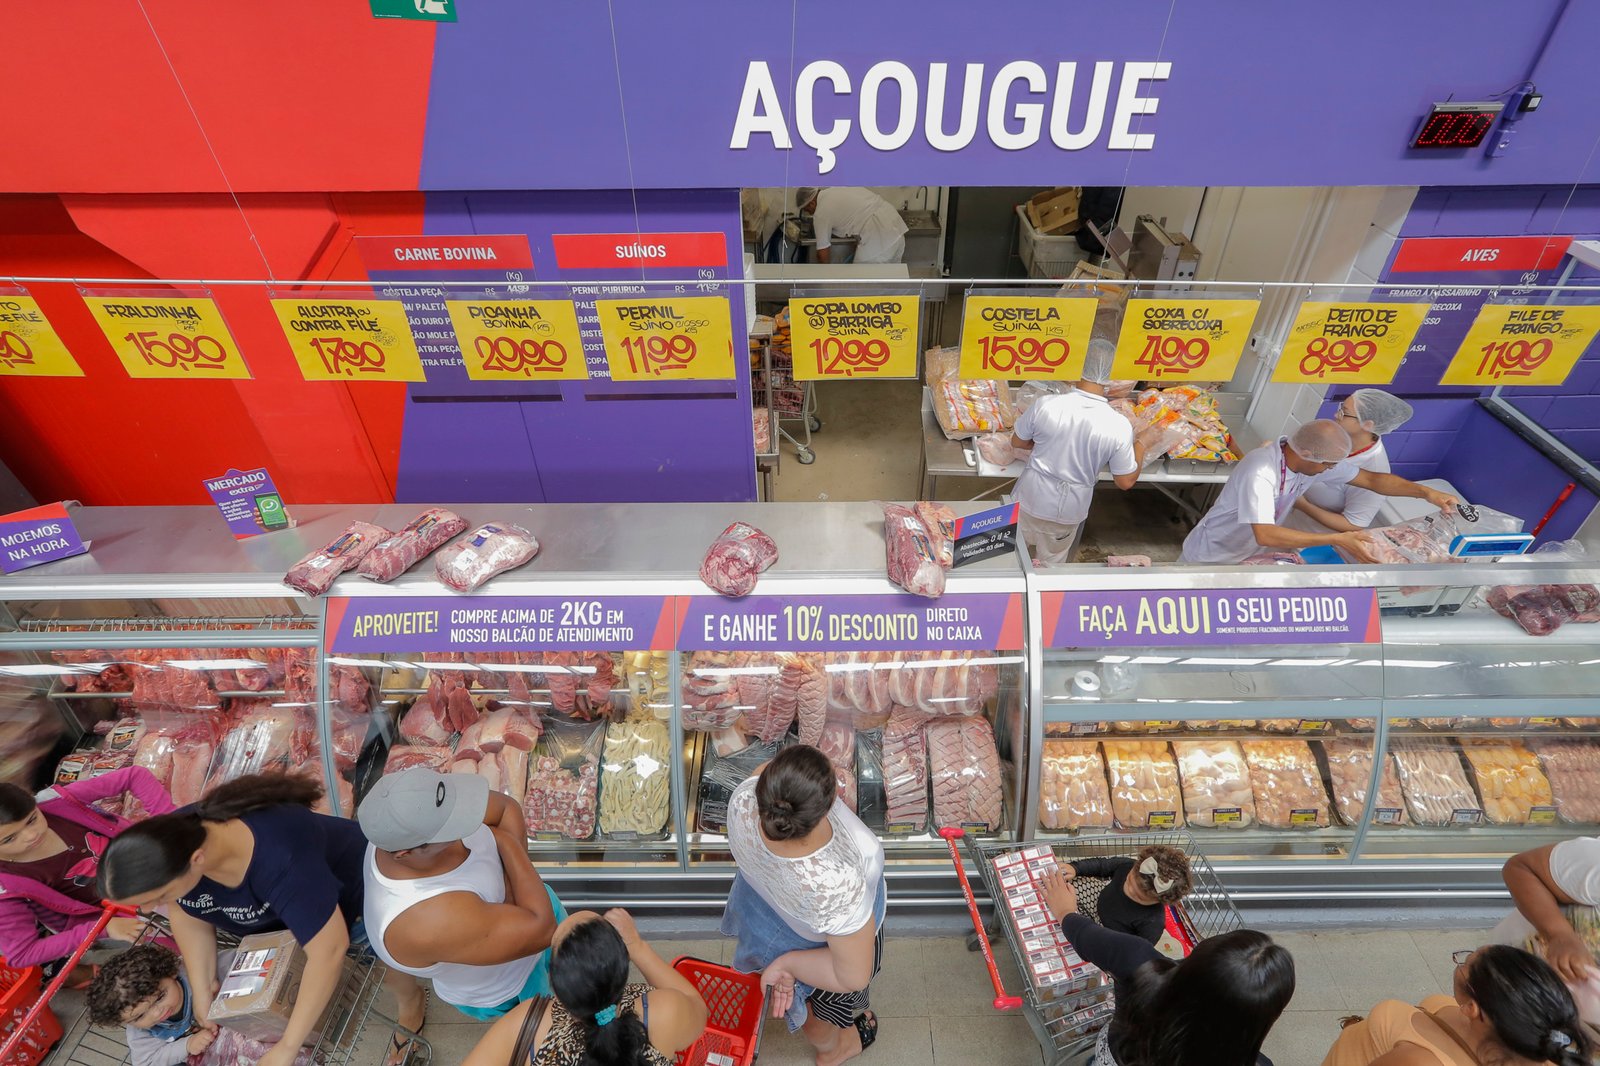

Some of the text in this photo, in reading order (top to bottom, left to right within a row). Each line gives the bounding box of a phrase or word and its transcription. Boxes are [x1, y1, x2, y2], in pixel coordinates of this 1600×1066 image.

[729, 60, 1173, 174] AÇOUGUE
[394, 246, 496, 261] CARNE BOVINA
[616, 242, 666, 258] SUÍNOS
[1461, 249, 1499, 262] AVES
[506, 271, 523, 282] (Kg)
[698, 269, 715, 279] (Kg)
[1520, 272, 1538, 282] (Kg)
[382, 288, 420, 296] COSTELA
[424, 288, 444, 298] PEÇA
[572, 286, 599, 294] PERNIL
[602, 286, 646, 294] PURURUCA
[103, 304, 202, 321] FRALDINHA
[298, 306, 359, 319] ALCATRA
[416, 303, 447, 311] PALETA
[467, 306, 541, 319] PICANHA
[616, 306, 684, 320] PERNIL
[804, 302, 902, 316] COPA LOMBO
[981, 307, 1060, 321] COSTELA
[1144, 308, 1184, 319] COXA
[1327, 308, 1398, 323] PEITO DE
[1541, 310, 1564, 320] DE
[290, 320, 346, 331] CONTRA
[827, 316, 893, 329] BARRIGA
[1143, 320, 1222, 331] SOBRECOXA
[1501, 323, 1563, 335] FRANGO
[1323, 324, 1388, 338] FRANGO
[124, 332, 227, 371] 15,90
[584, 344, 604, 352] COST
[310, 337, 386, 376] 17,90
[440, 357, 456, 366] FILÉ
[586, 358, 608, 366] COPA
[620, 335, 697, 376] 11,99
[810, 337, 890, 376] 12,99
[978, 336, 1070, 375] 15,90
[1134, 335, 1210, 376] 4,99
[1300, 338, 1377, 378] 8,99
[1476, 338, 1553, 379] 11,99
[208, 472, 266, 491] MERCADO
[229, 485, 255, 496] extra
[1461, 504, 1475, 521] eara
[971, 515, 1002, 530] AÇOUGUE
[1, 523, 62, 547] MOEMOS
[8, 538, 69, 561] NA HORA
[451, 602, 623, 626] COMPRE ACIMA DE 2KG EM
[926, 608, 968, 622] DIRETO
[1079, 596, 1348, 639] FAÇA AQUI O SEU PEDIDO
[353, 611, 438, 638] APROVEITE!
[704, 605, 918, 641] E GANHE 10% DESCONTO
[450, 626, 634, 643] NOSSO BALCÃO DE ATENDIMENTO
[926, 626, 982, 640] NO CAIXA
[257, 902, 270, 916] MIN
